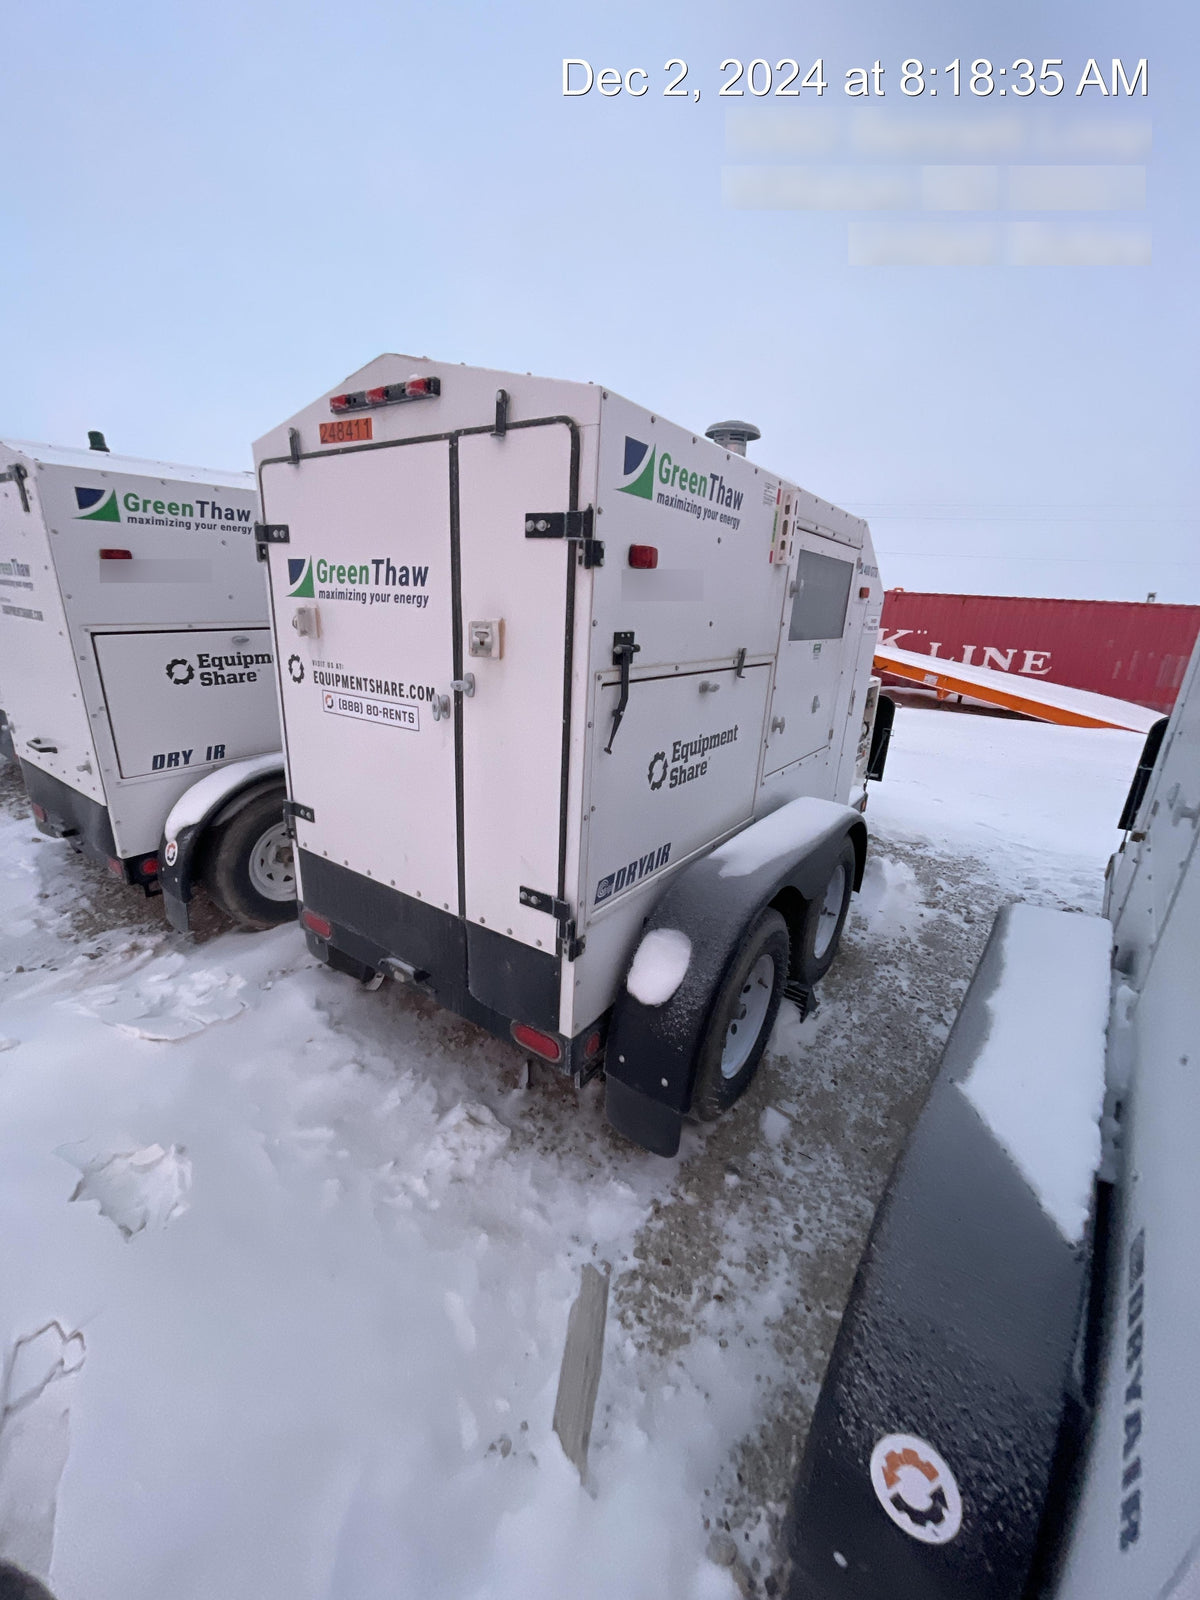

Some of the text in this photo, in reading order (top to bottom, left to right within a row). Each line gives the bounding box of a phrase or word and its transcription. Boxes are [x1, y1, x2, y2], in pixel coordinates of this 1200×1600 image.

[320, 418, 370, 443] 248411
[659, 452, 744, 511] GreenThaw
[123, 492, 251, 522] GreenThaw
[656, 492, 741, 531] maximizing your energy
[127, 516, 253, 535] maximizing your energy
[316, 558, 429, 587] GreenThaw
[319, 588, 429, 608] maximizing your energy
[197, 652, 273, 670] Equipm
[200, 671, 257, 687] Share
[313, 670, 435, 702] EQUIPMENTSHARE.COM
[338, 698, 363, 714] (888)
[671, 724, 739, 763] Equipment
[669, 760, 708, 789] Share
[614, 842, 672, 894] DRYAIR
